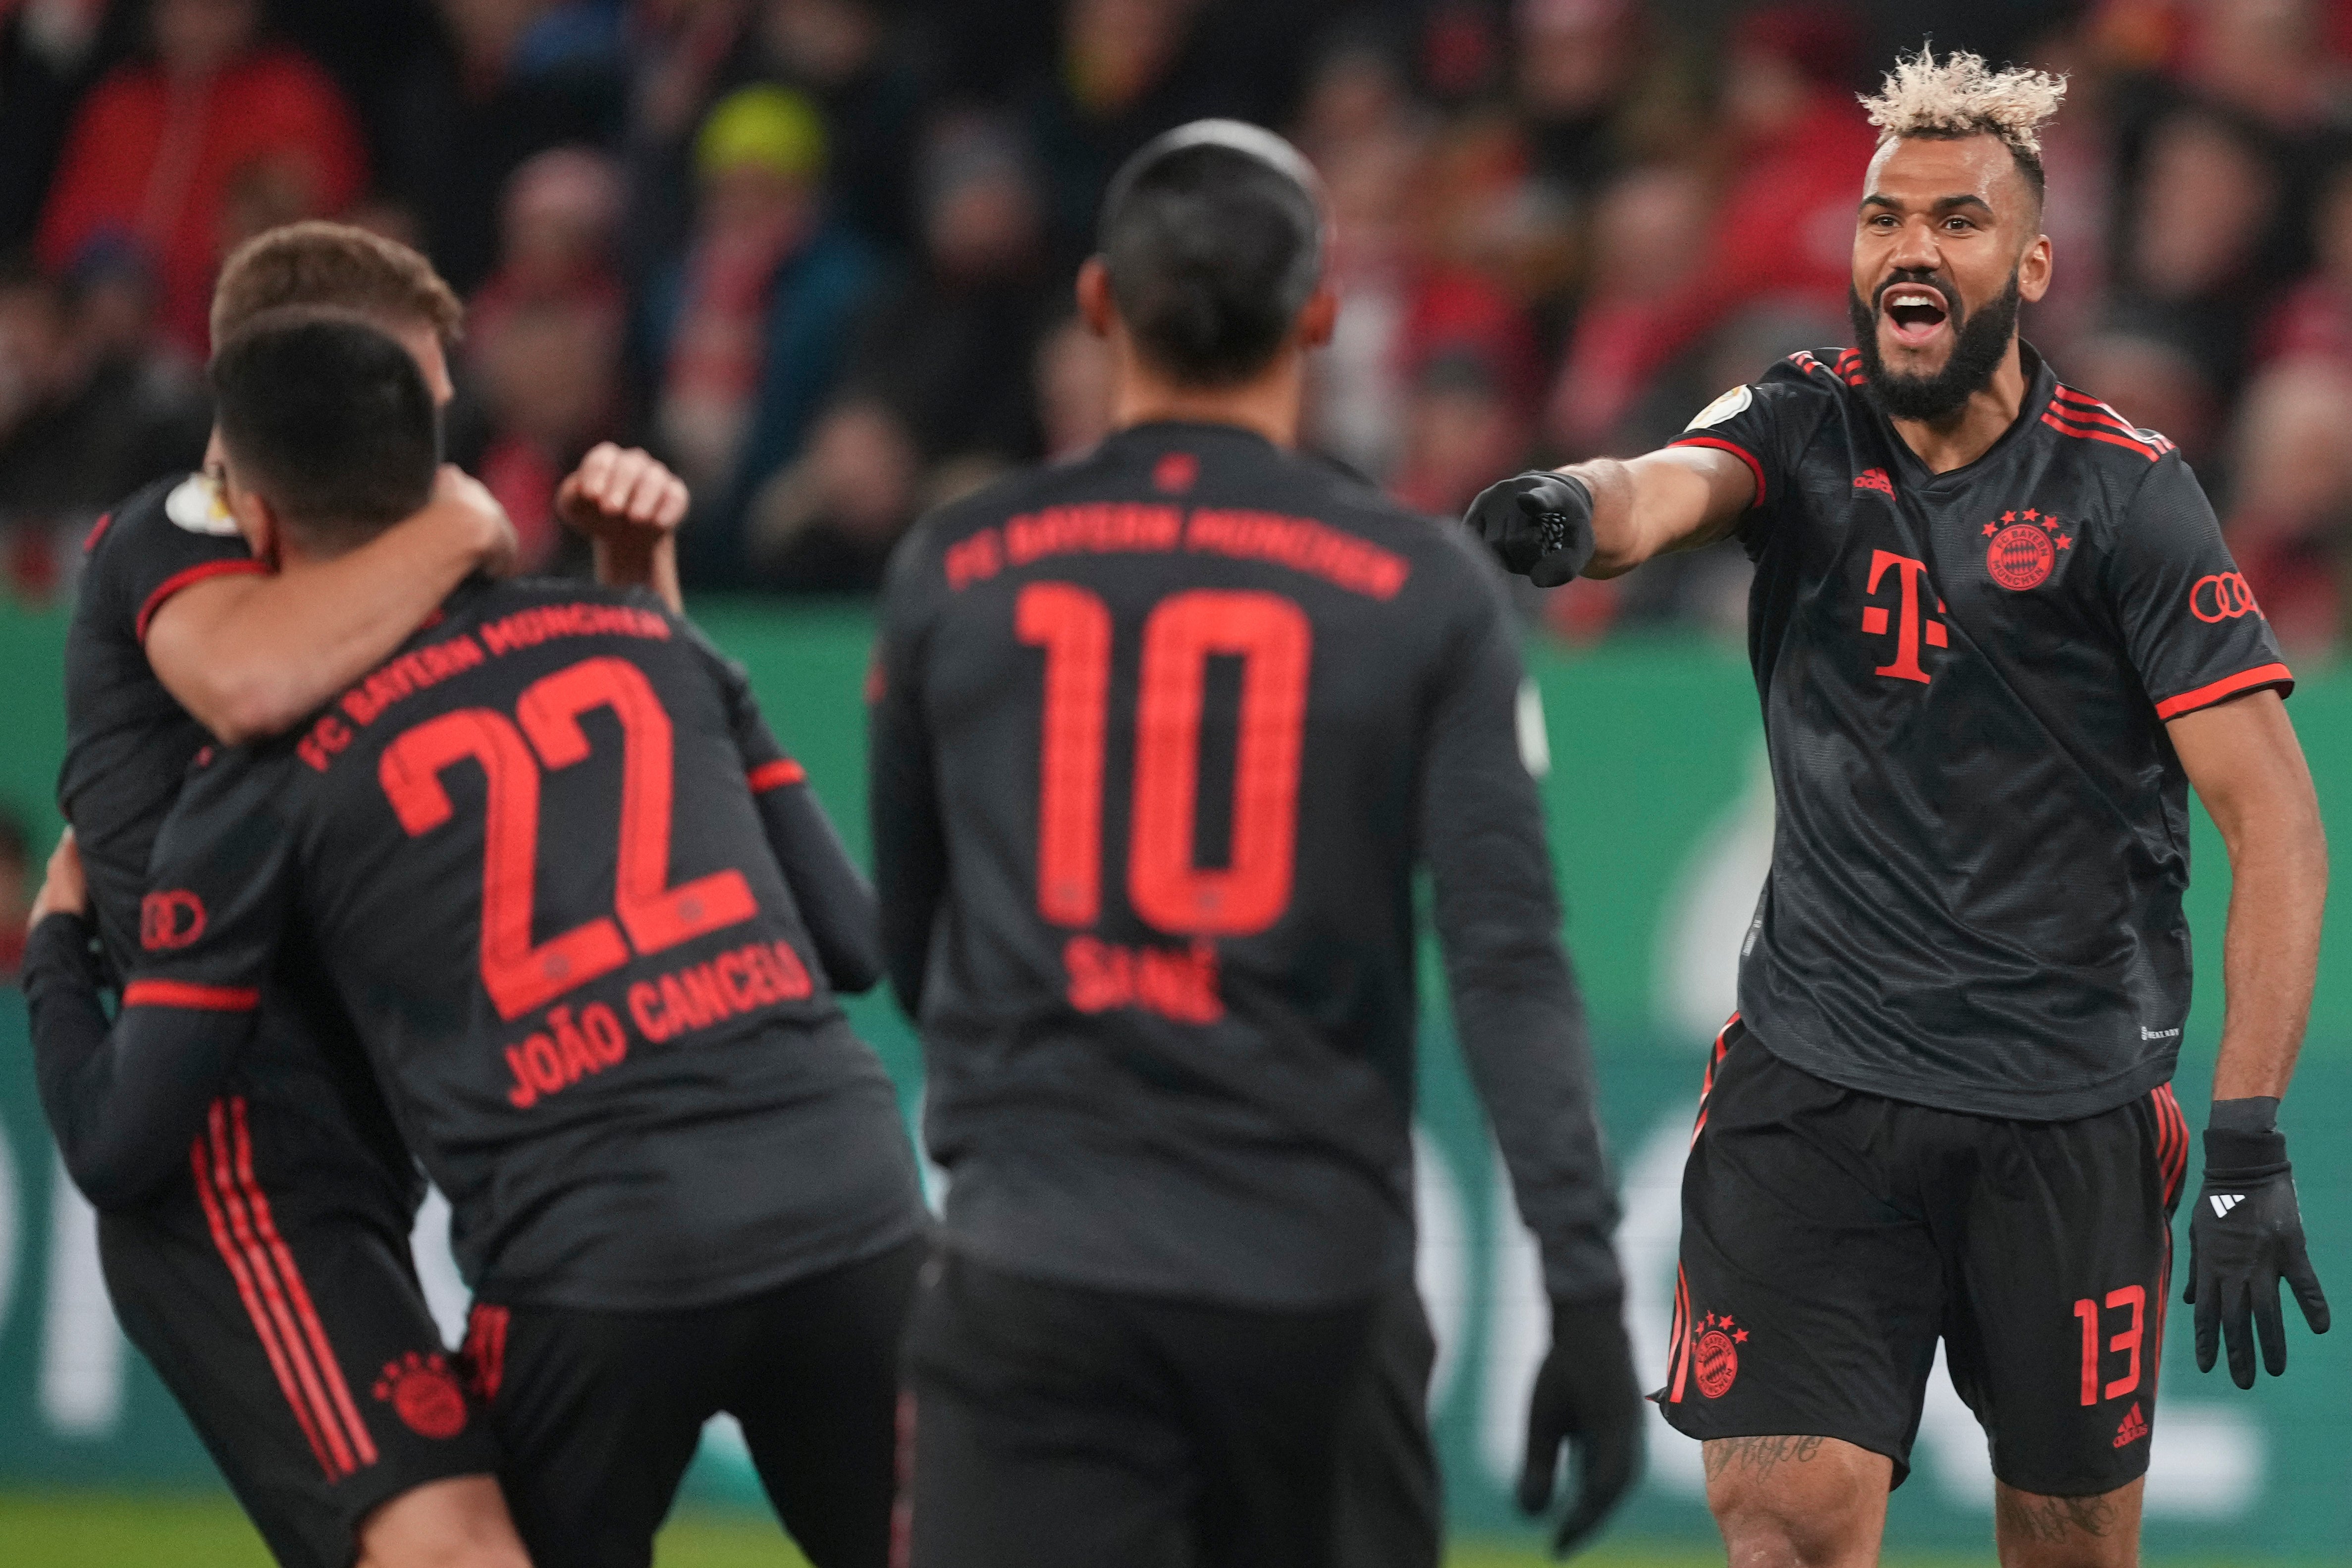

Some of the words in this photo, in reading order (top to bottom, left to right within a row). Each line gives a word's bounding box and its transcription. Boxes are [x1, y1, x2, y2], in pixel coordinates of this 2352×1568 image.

[1853, 476, 1897, 502] adid
[945, 528, 1004, 590] FC
[1005, 503, 1182, 565] BAYERN
[1996, 535, 2010, 549] FC
[2011, 530, 2050, 557] BAYERN
[297, 716, 352, 771] FC
[339, 634, 485, 726] BAYERN
[1016, 582, 1313, 936] 10
[378, 655, 758, 1022] 22
[504, 1002, 627, 1109] JOÃO
[2074, 1285, 2145, 1406] 13
[2113, 1425, 2149, 1449] adidas
